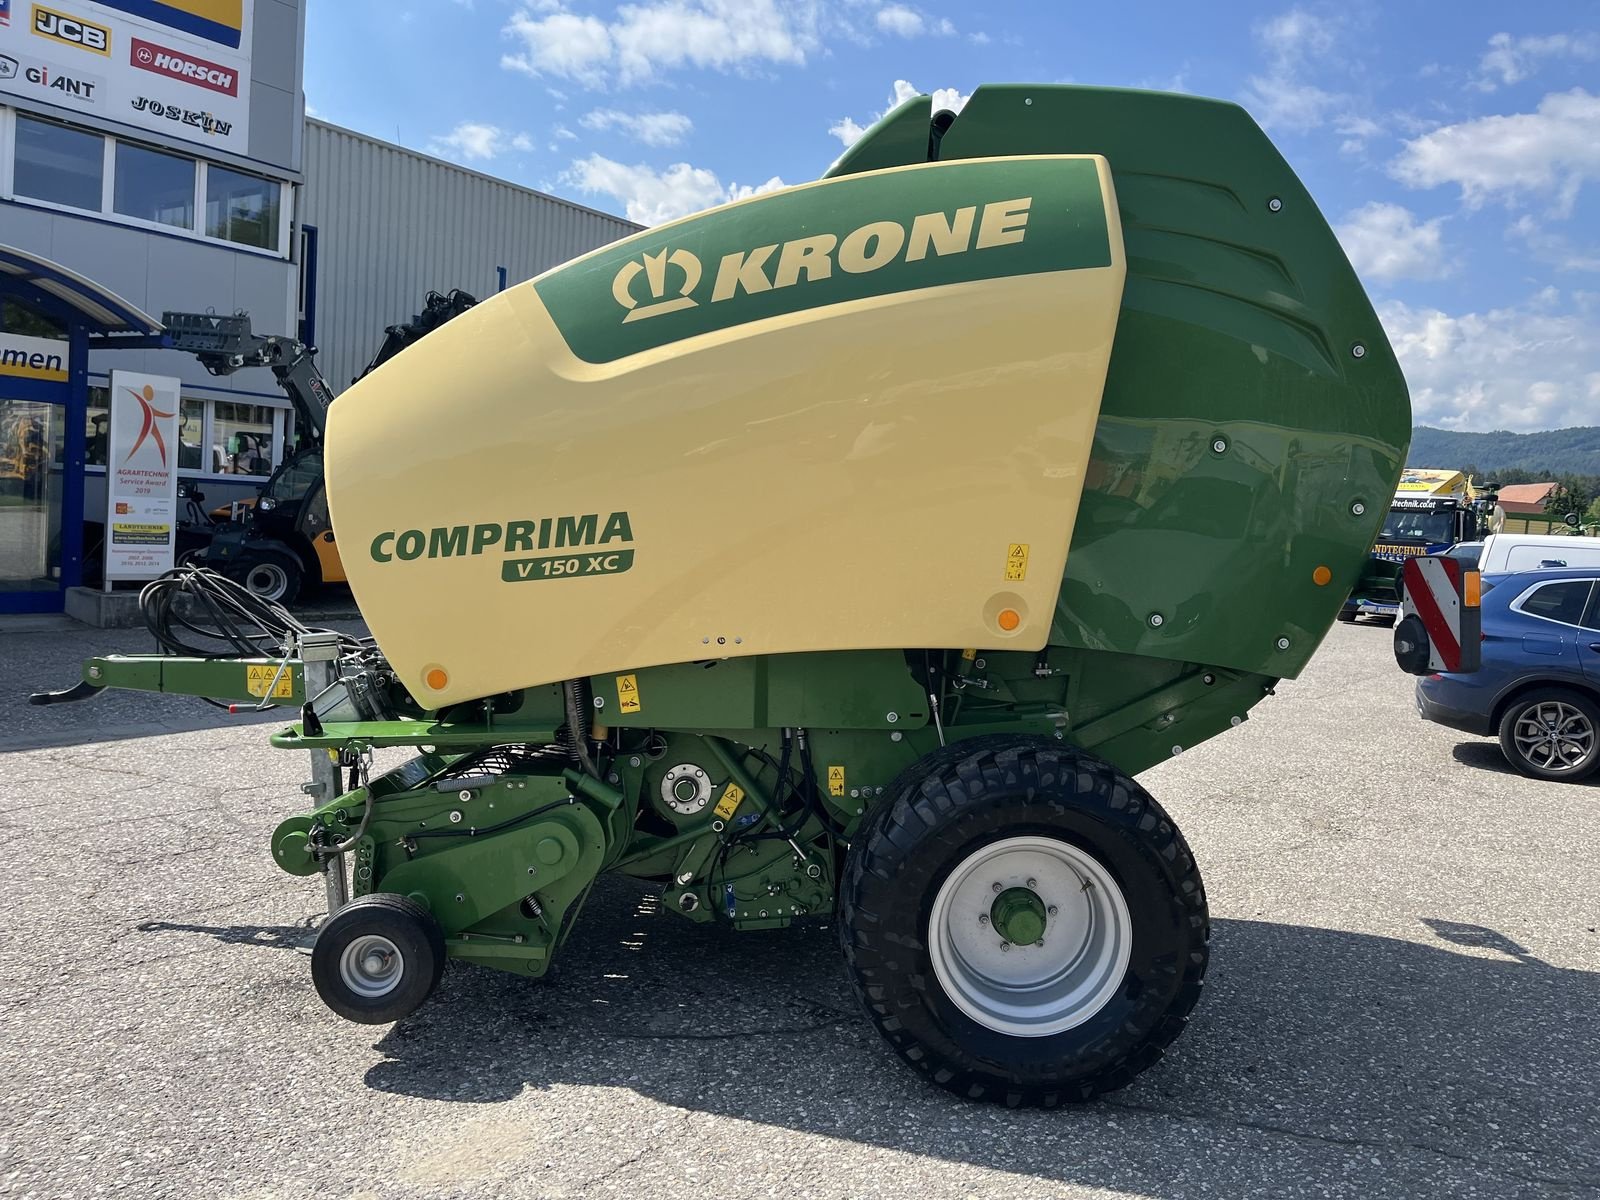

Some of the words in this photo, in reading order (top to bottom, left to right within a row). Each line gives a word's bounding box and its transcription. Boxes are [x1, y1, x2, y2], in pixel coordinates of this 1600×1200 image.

[37, 12, 106, 50] JCB
[154, 53, 233, 89] HORSCH
[131, 96, 233, 136] JOSKIN
[711, 197, 1033, 303] KRONE
[0, 348, 62, 372] men
[117, 468, 170, 478] AGRARTECHNIK
[119, 477, 144, 486] Service
[145, 479, 167, 487] Award
[370, 511, 634, 563] COMPRIMA
[516, 563, 534, 578] V
[540, 558, 580, 576] 150
[585, 555, 620, 573] XC
